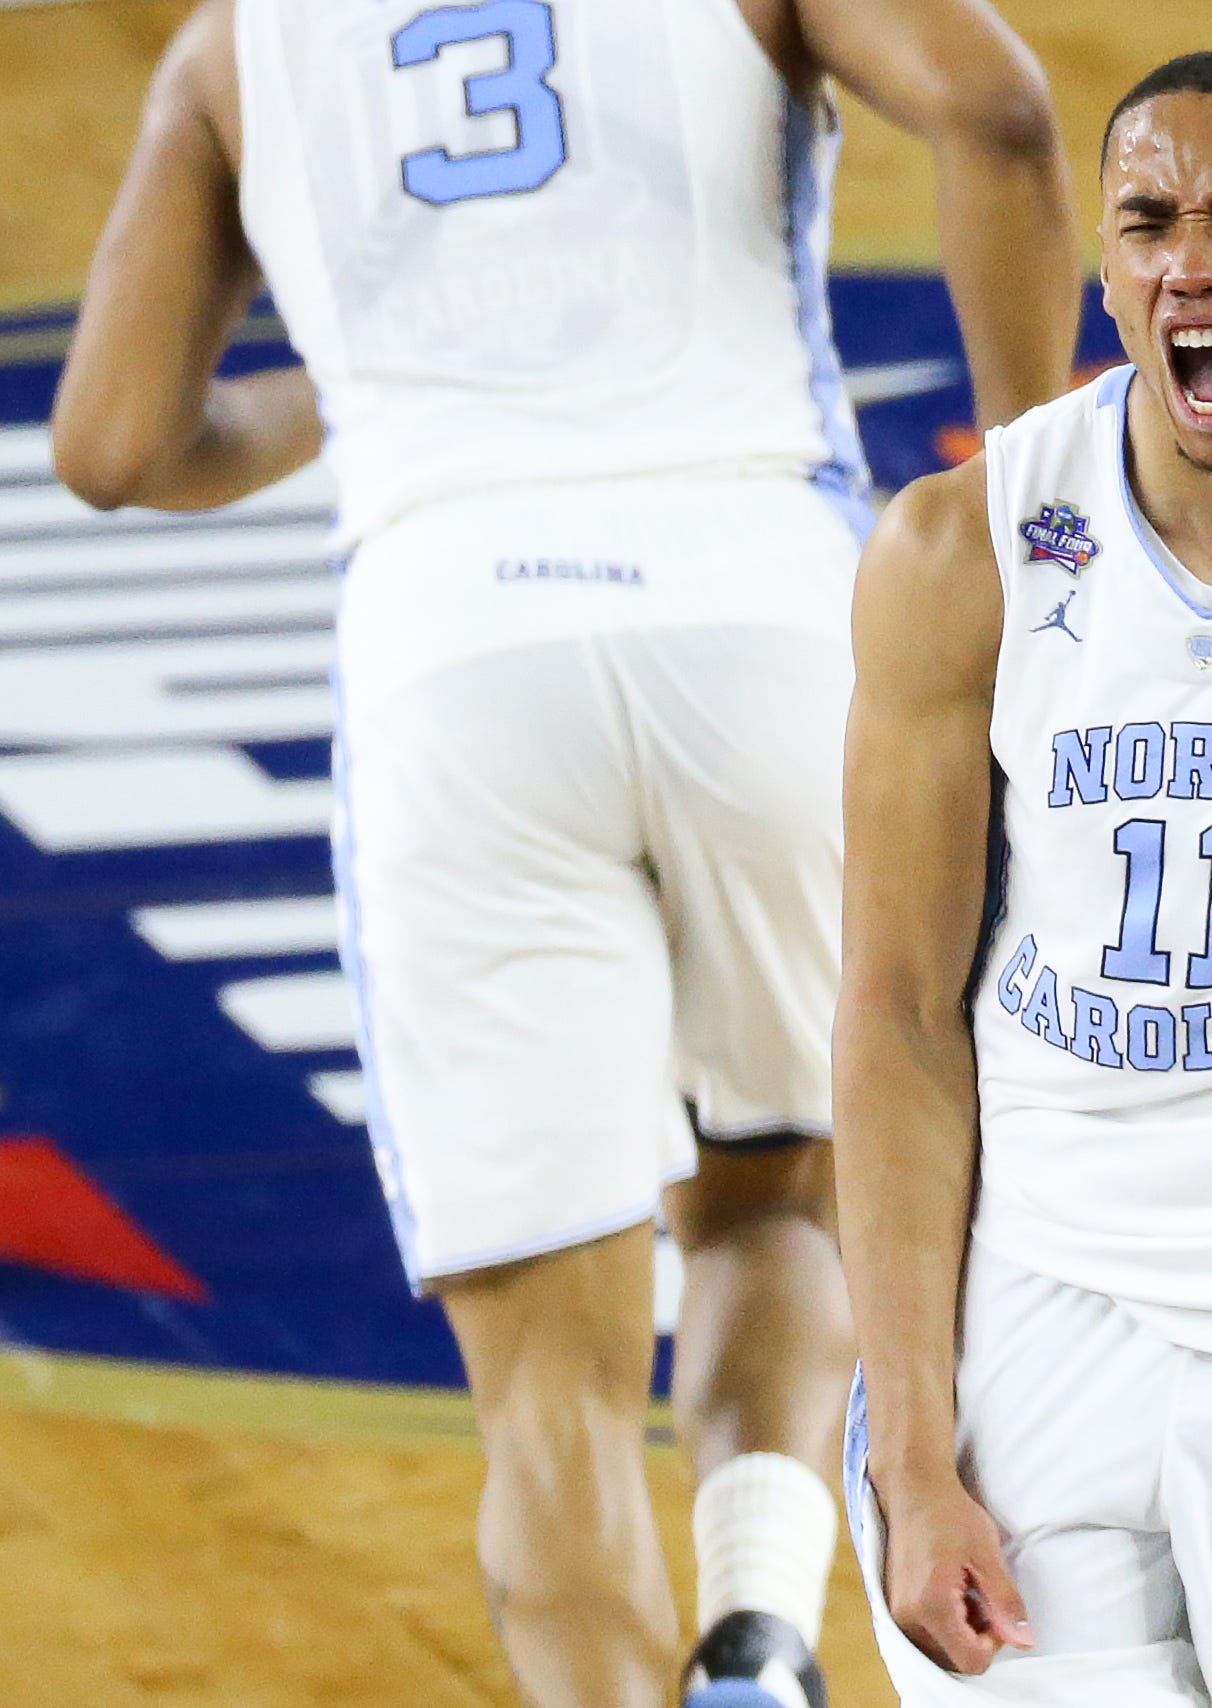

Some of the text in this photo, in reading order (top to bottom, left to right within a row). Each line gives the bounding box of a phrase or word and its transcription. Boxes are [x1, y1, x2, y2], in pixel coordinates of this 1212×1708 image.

[391, 0, 566, 205] 3
[1025, 522, 1058, 546] FINAL
[1058, 534, 1093, 553] FOUR
[495, 559, 644, 585] CAROLINA
